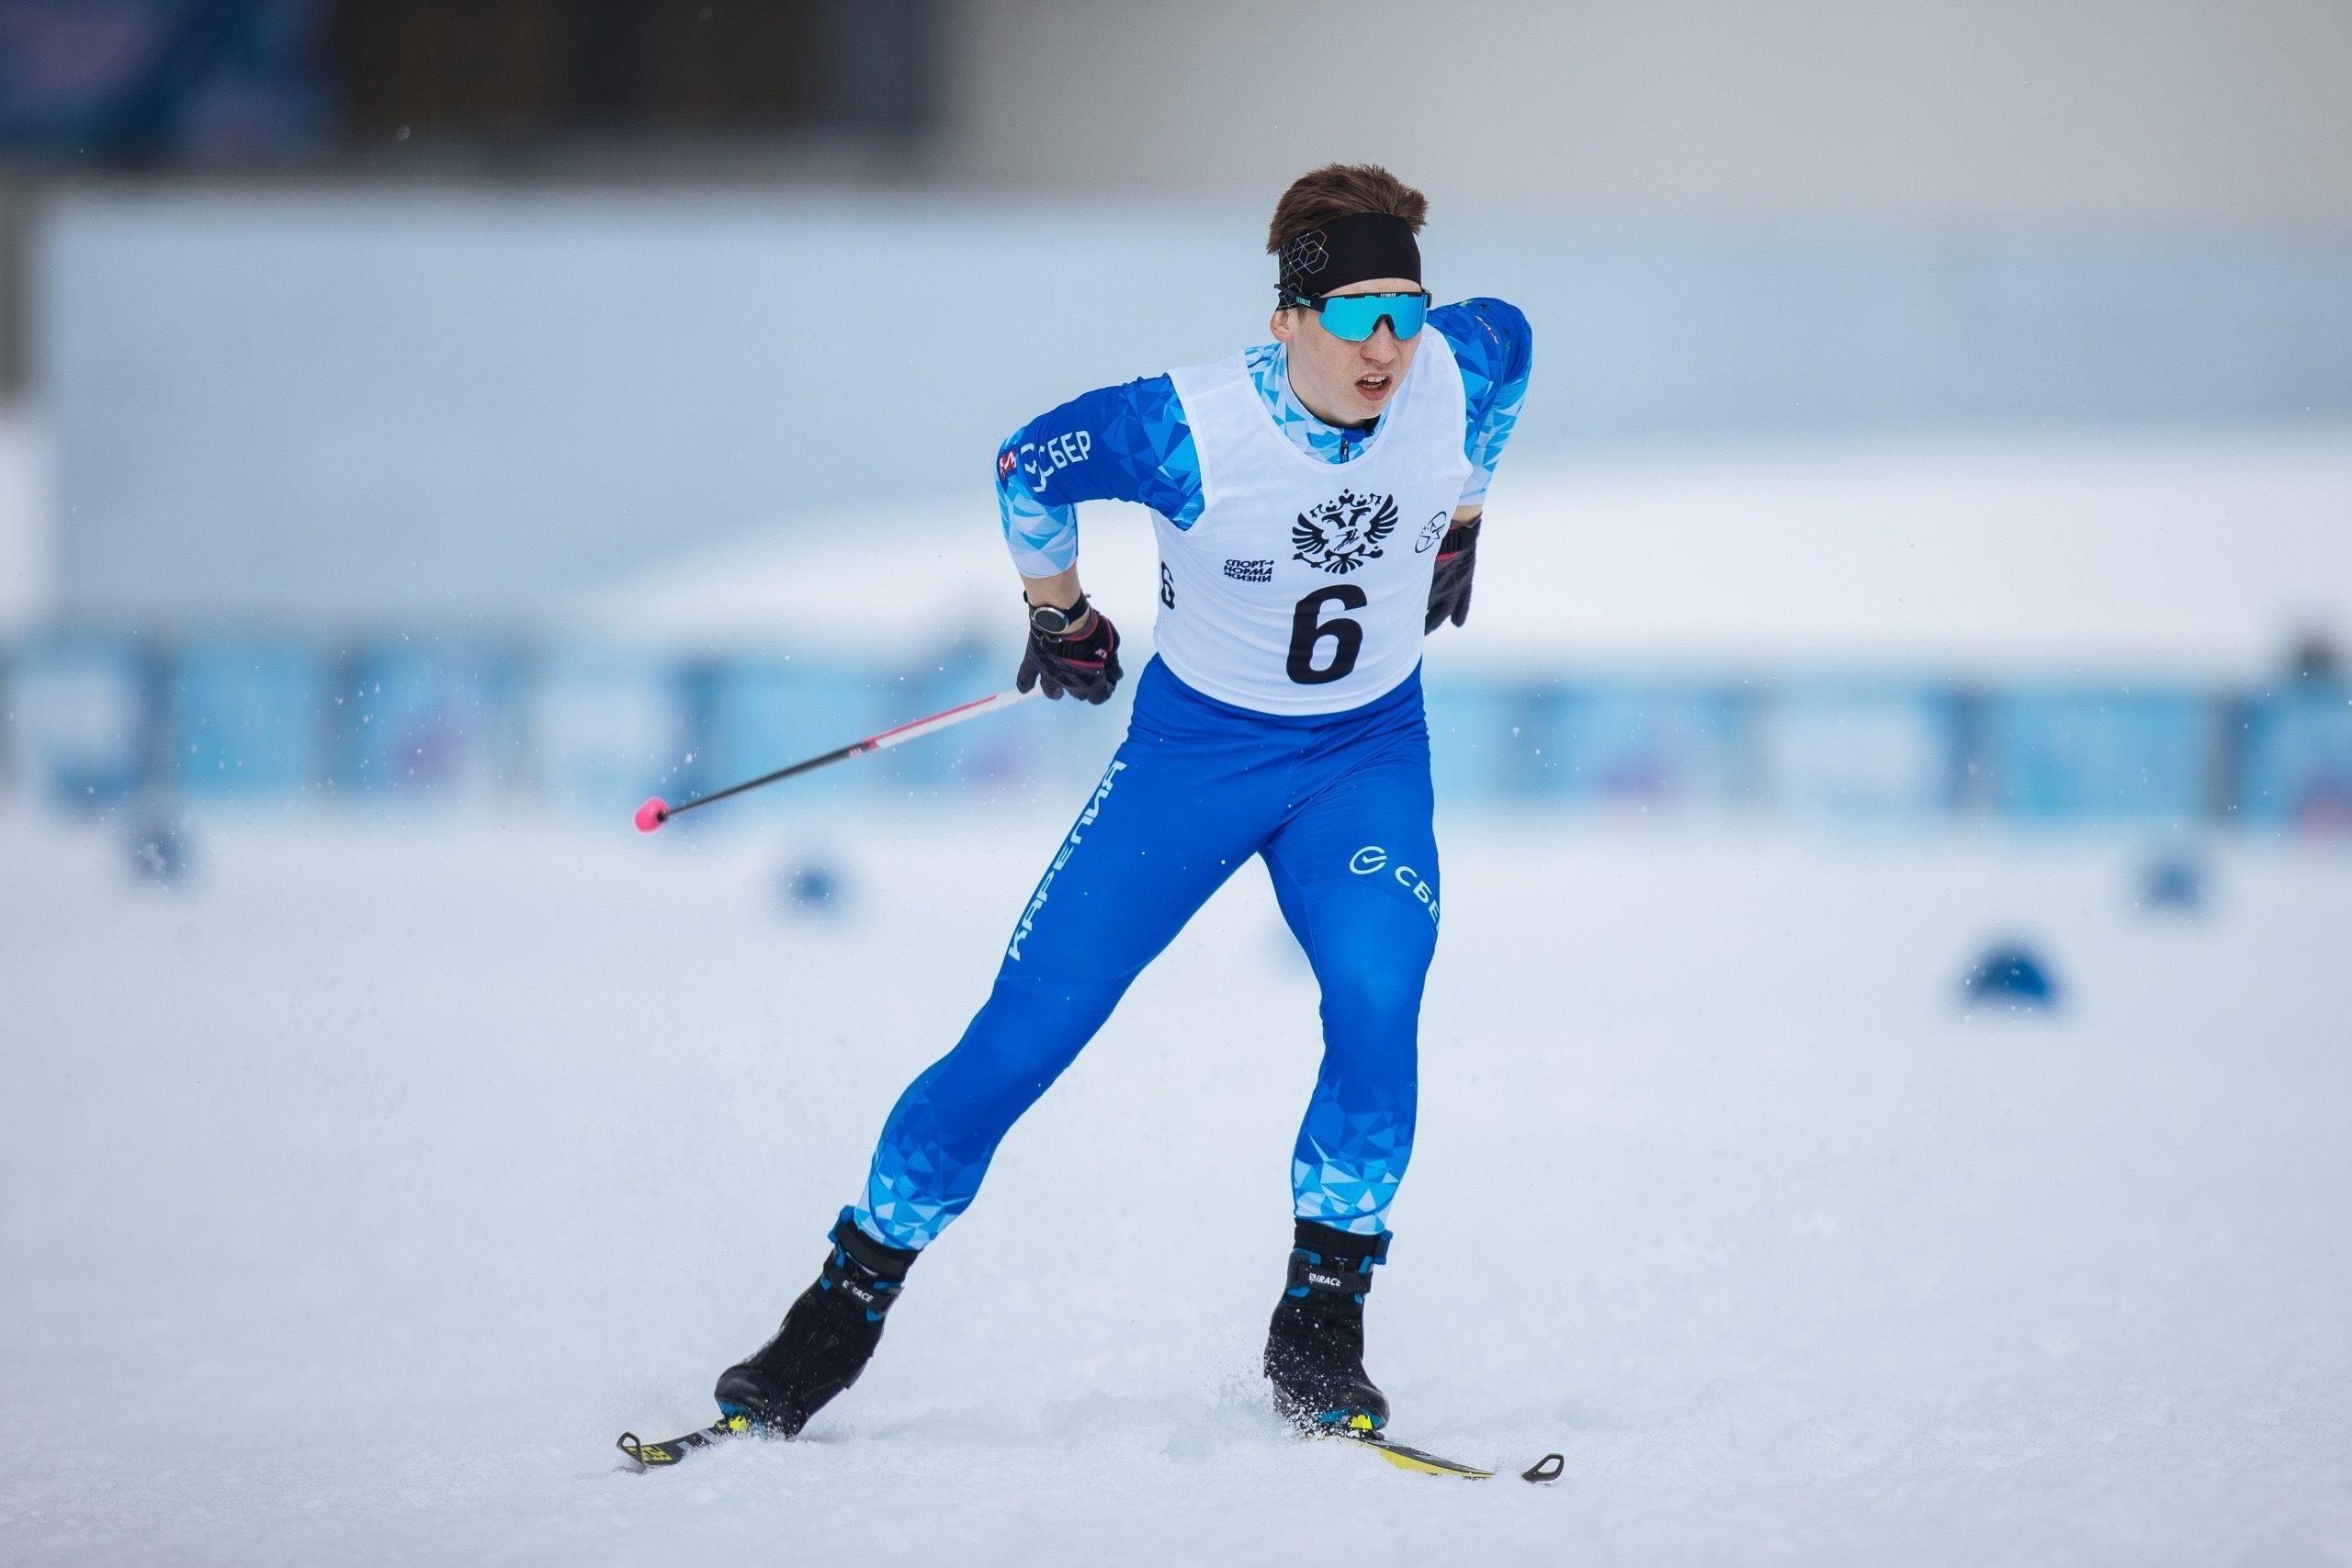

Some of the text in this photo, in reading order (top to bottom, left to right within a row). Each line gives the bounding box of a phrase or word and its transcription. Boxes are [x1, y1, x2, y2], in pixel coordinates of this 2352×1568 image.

[1039, 430, 1091, 478] СБЕР
[1223, 570, 1272, 582] ЖИЗНИ
[1224, 565, 1272, 576] НОРМА
[1226, 559, 1266, 569] СПОРТ
[1286, 584, 1368, 685] 6
[1395, 865, 1440, 931] СБЕ
